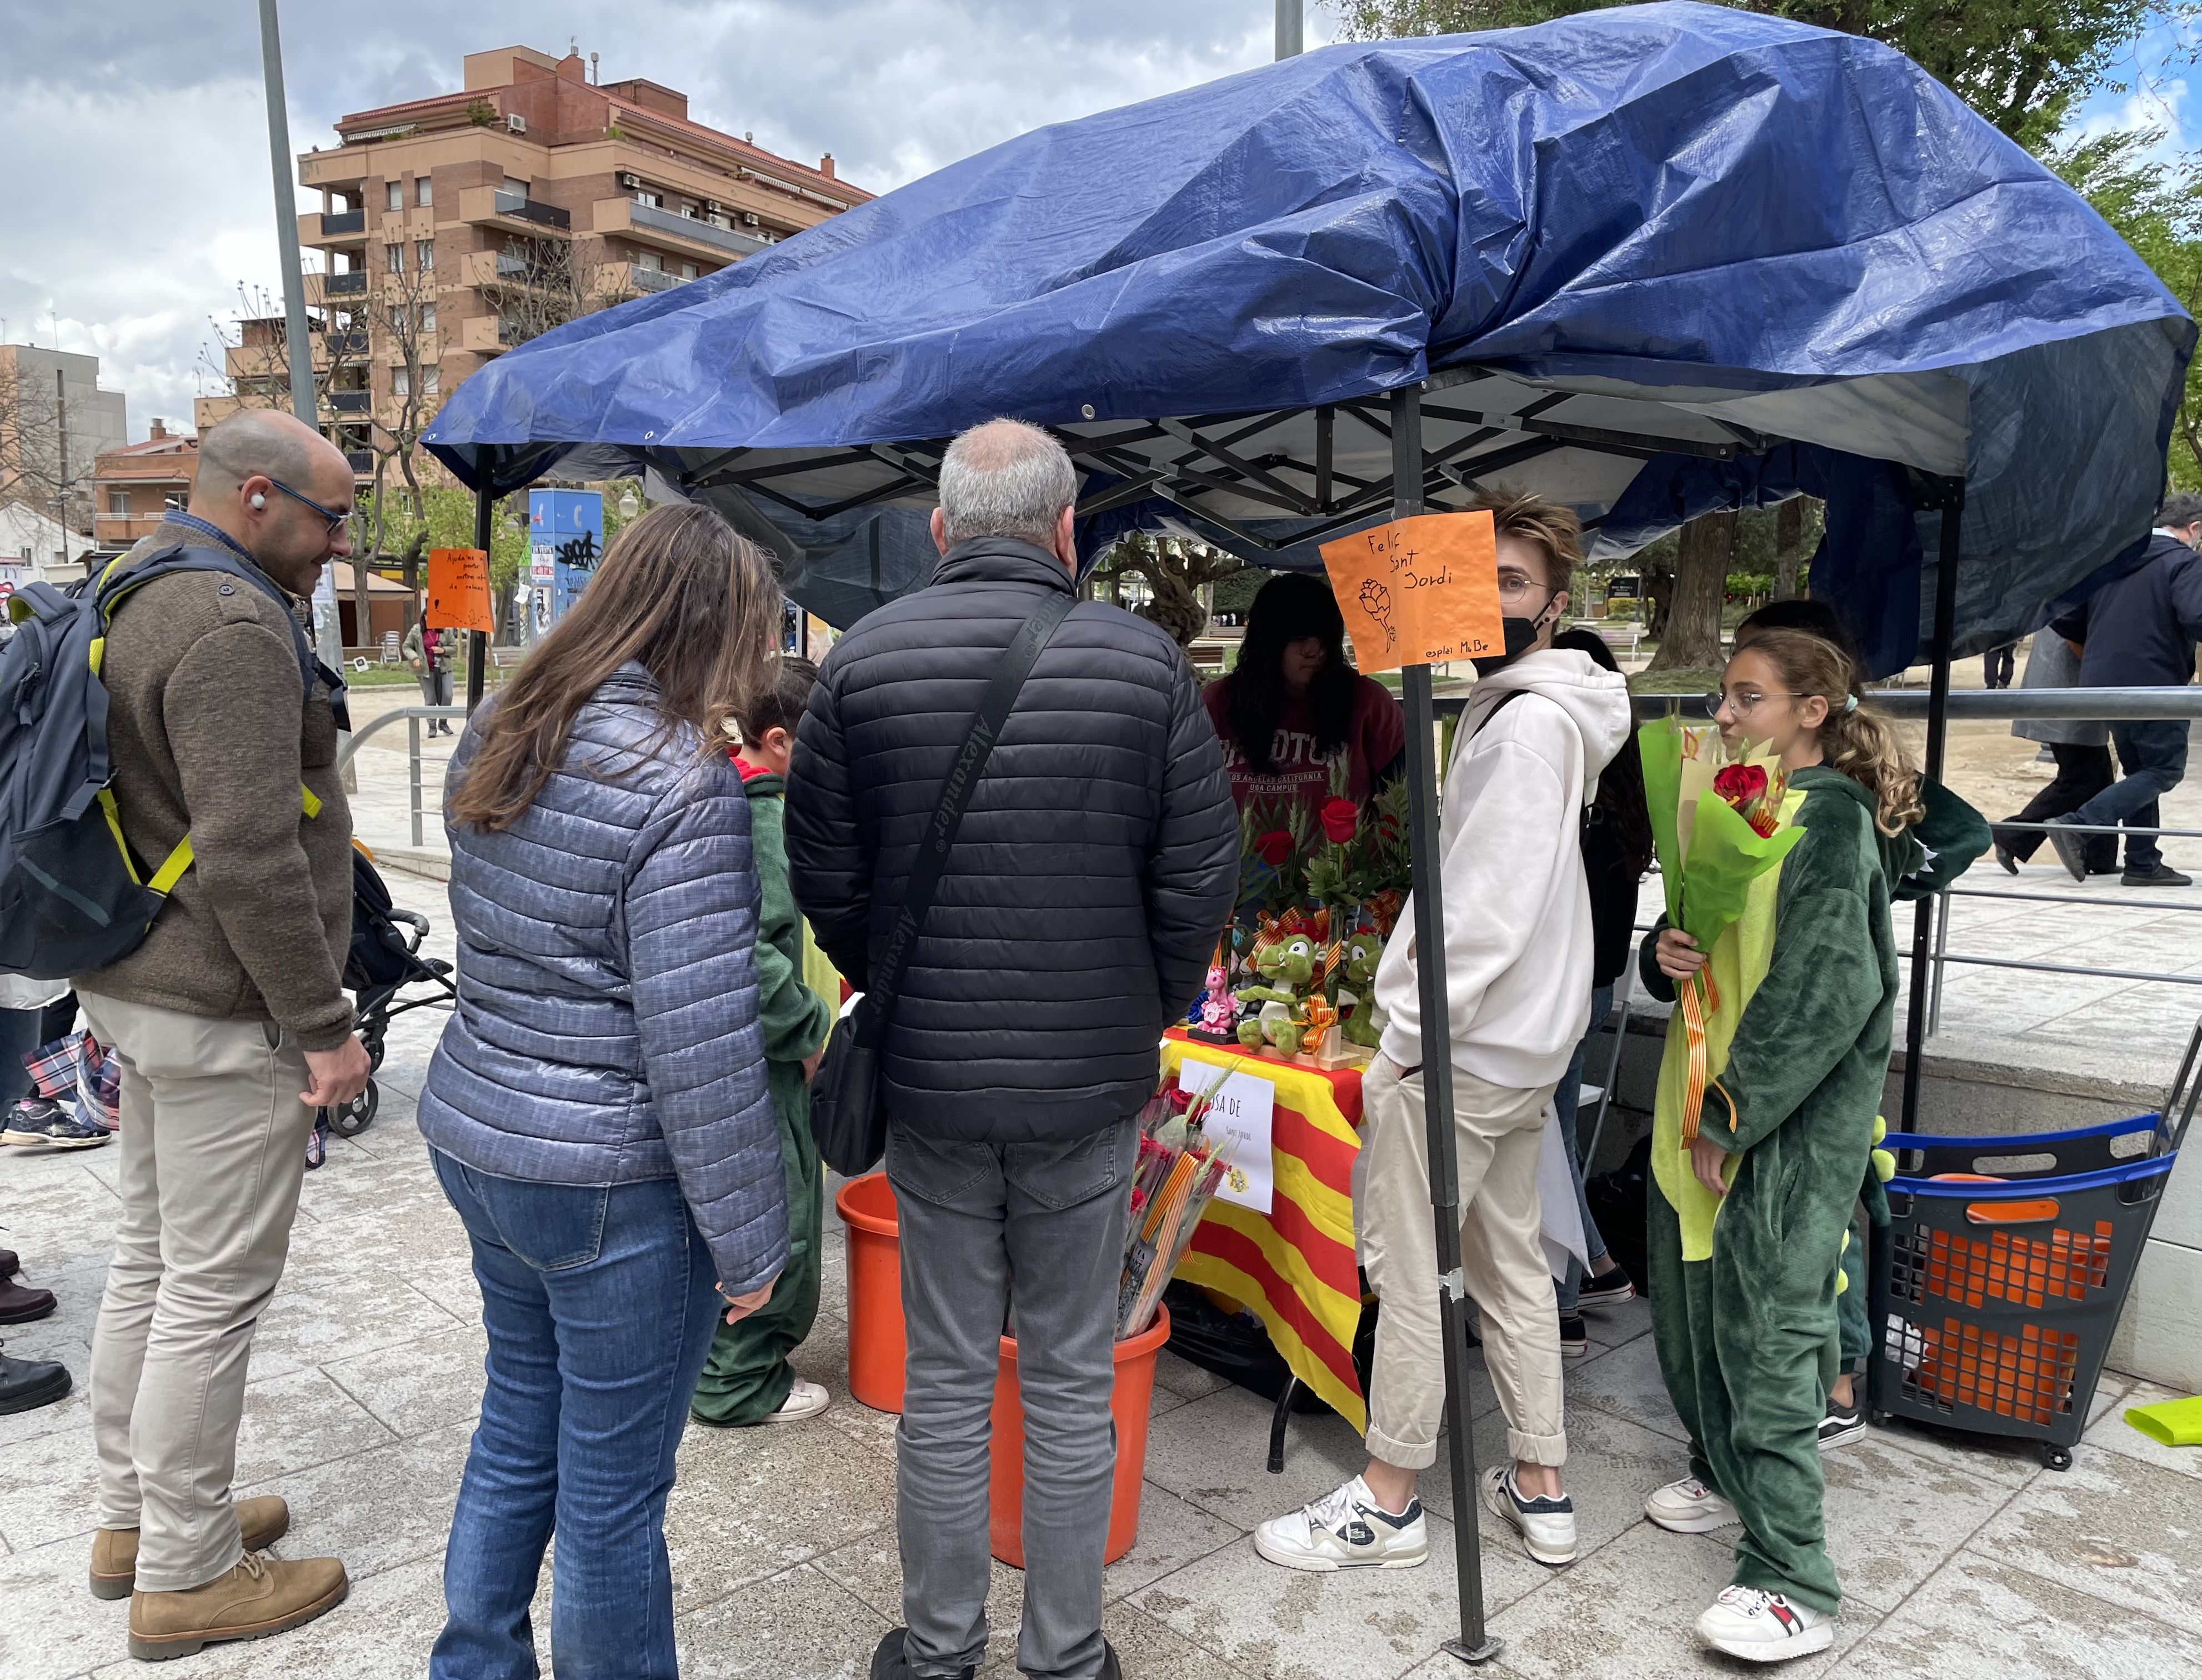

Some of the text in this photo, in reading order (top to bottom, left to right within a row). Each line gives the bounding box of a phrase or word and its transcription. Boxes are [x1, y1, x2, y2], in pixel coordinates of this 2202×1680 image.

[1390, 549, 1419, 572] Sant
[1404, 566, 1452, 589] Jordi
[1277, 772, 1322, 783] CALIFORNIA
[1229, 1098, 1241, 1117] DE
